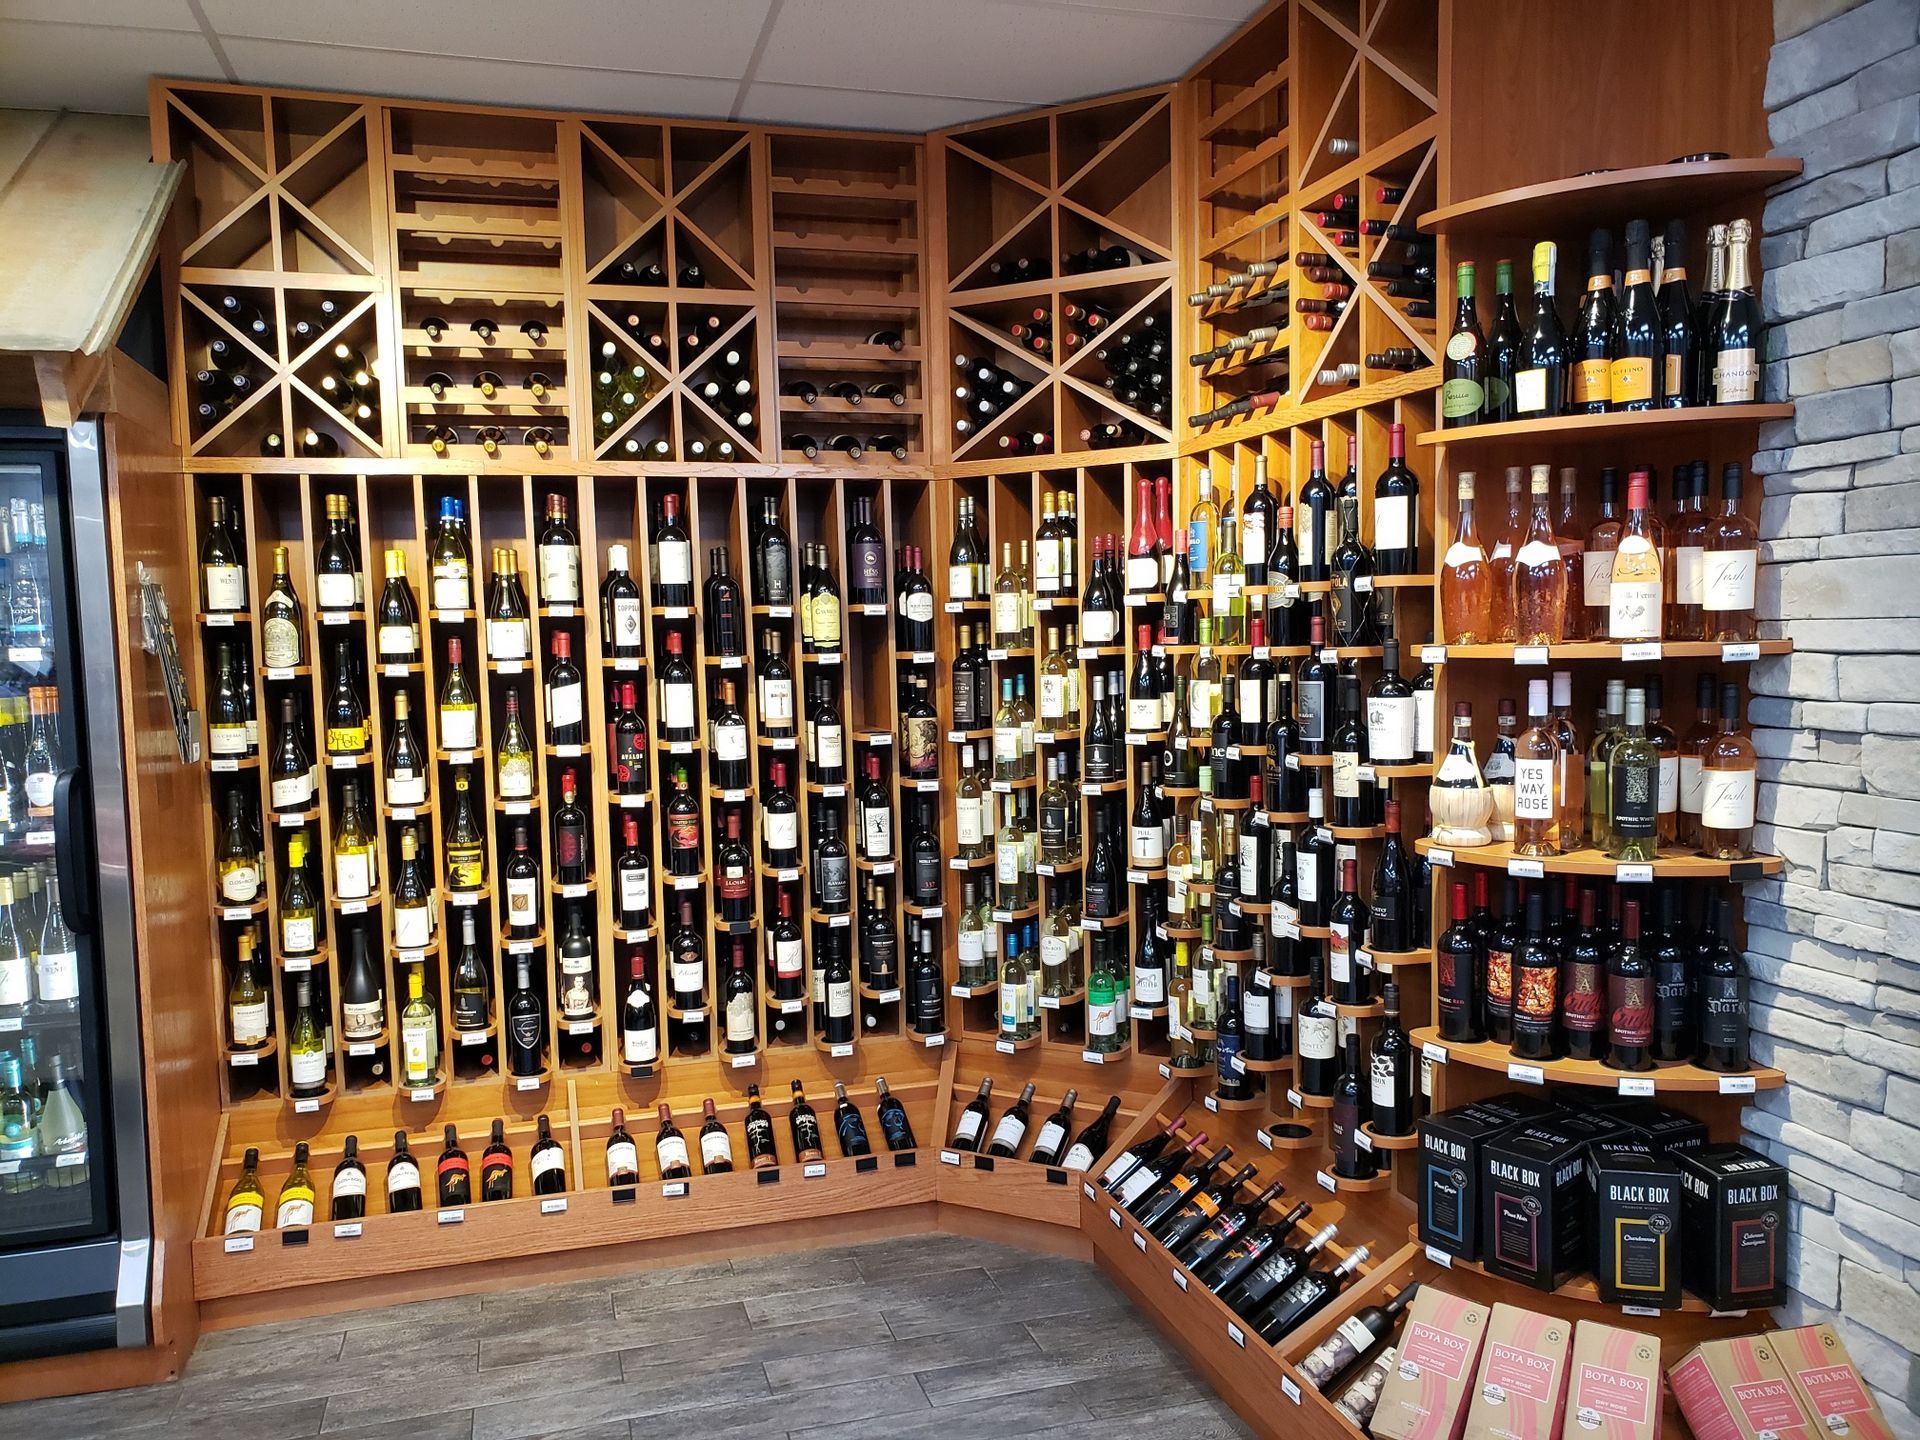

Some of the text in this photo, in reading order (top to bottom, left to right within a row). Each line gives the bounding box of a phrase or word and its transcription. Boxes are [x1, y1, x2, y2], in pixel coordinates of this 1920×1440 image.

[1714, 370, 1758, 380] CHANDON
[1521, 768, 1543, 780] YES
[1520, 784, 1545, 794] WAY
[1712, 780, 1748, 811] Josh
[1518, 795, 1548, 810] ROSÉ
[1524, 1128, 1569, 1144] BLACK BOX
[1425, 1134, 1466, 1161] BLACK BOX
[1490, 1160, 1540, 1188] BLACK BOX
[1555, 1167, 1572, 1186] BLACK
[1572, 1158, 1582, 1176] BOX
[1610, 1185, 1670, 1204] BLACK BOX
[1694, 1178, 1709, 1200] BOX
[1728, 1184, 1778, 1204] BLACK BOX
[1624, 1234, 1656, 1244] Chardonnay
[1414, 1326, 1466, 1352] BOTA BOX
[1495, 1348, 1550, 1372] BOTA BOX
[1585, 1370, 1644, 1392] BOTA BOX
[1804, 1369, 1852, 1386] BOTA BOX
[1737, 1384, 1786, 1400] BOTA BOX
